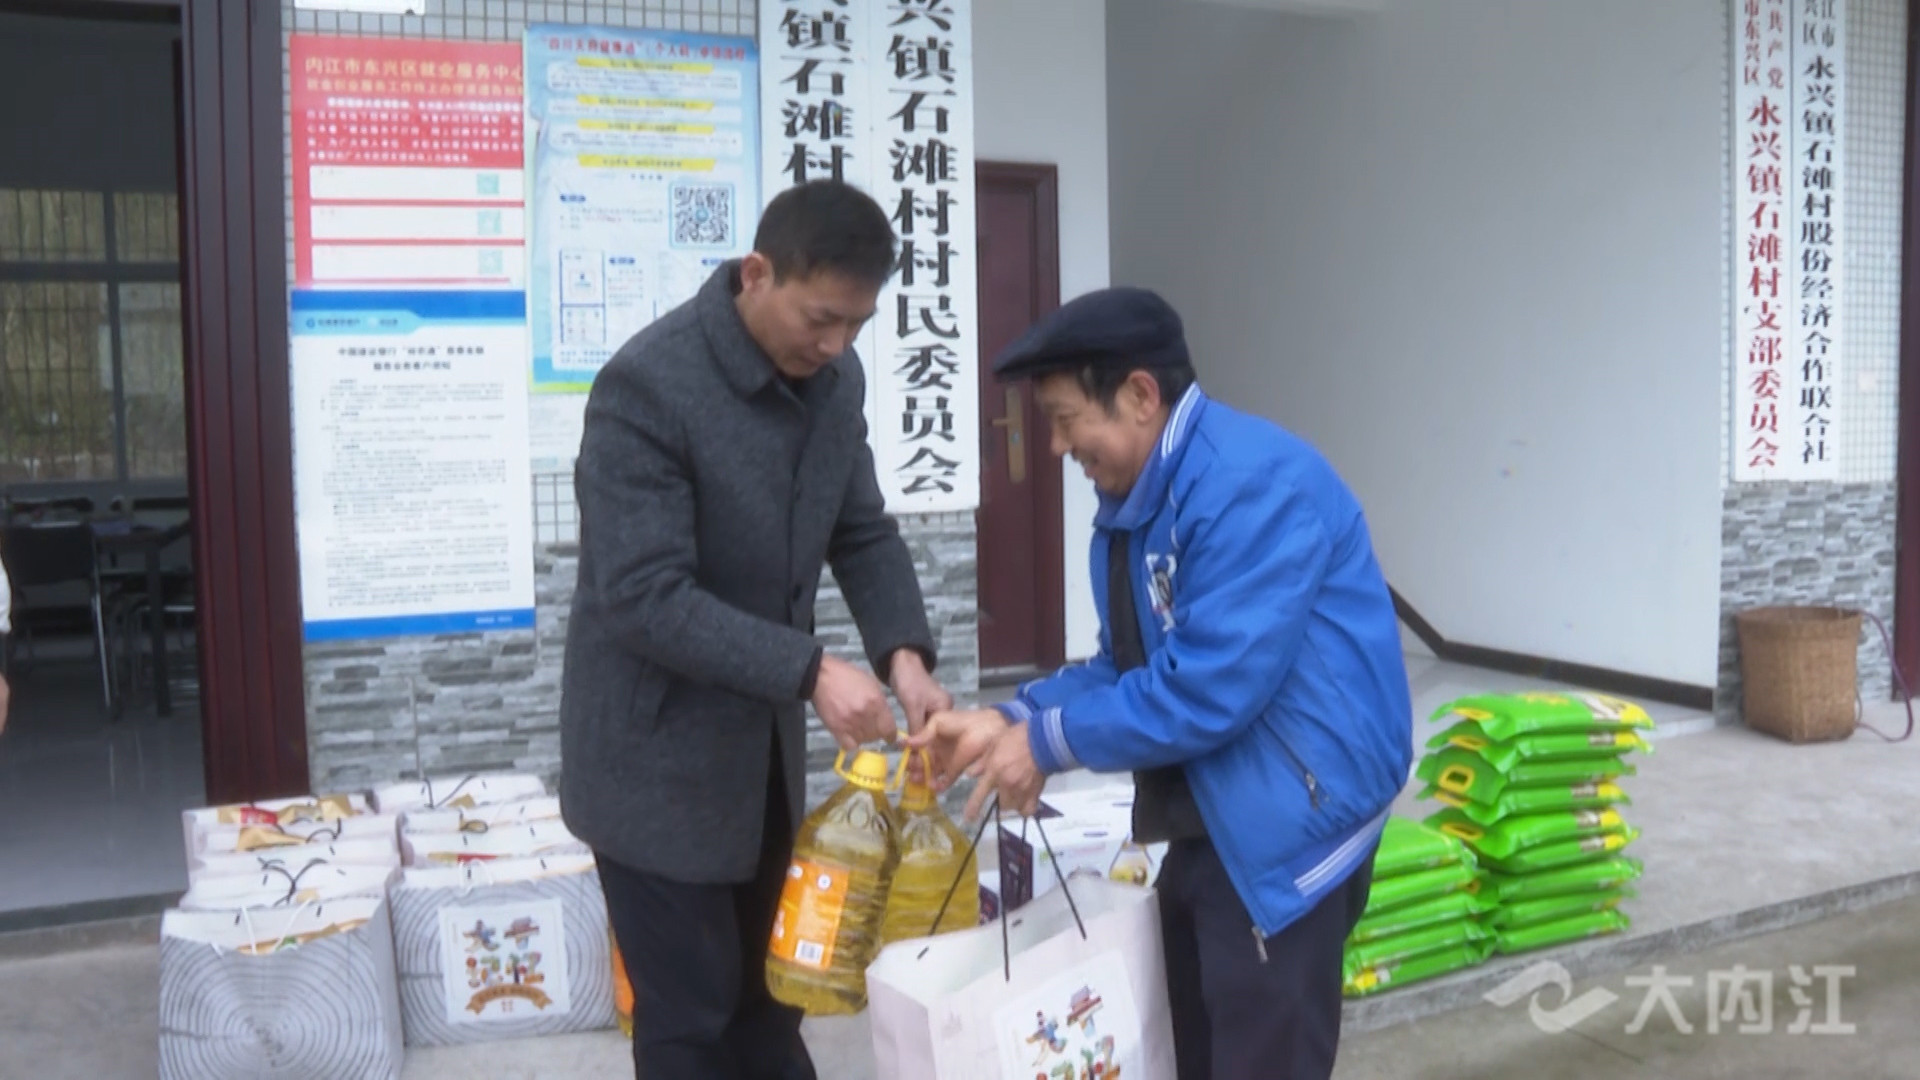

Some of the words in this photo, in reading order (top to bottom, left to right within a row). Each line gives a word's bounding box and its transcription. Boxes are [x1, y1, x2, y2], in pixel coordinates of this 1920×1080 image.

[778, 0, 855, 184] 镇石滩村
[1767, 0, 1784, 89] 共产党
[886, 0, 963, 496] 兴镇石滩村村民委员会
[1747, 95, 1782, 468] 永兴镇石滩村支部委员会
